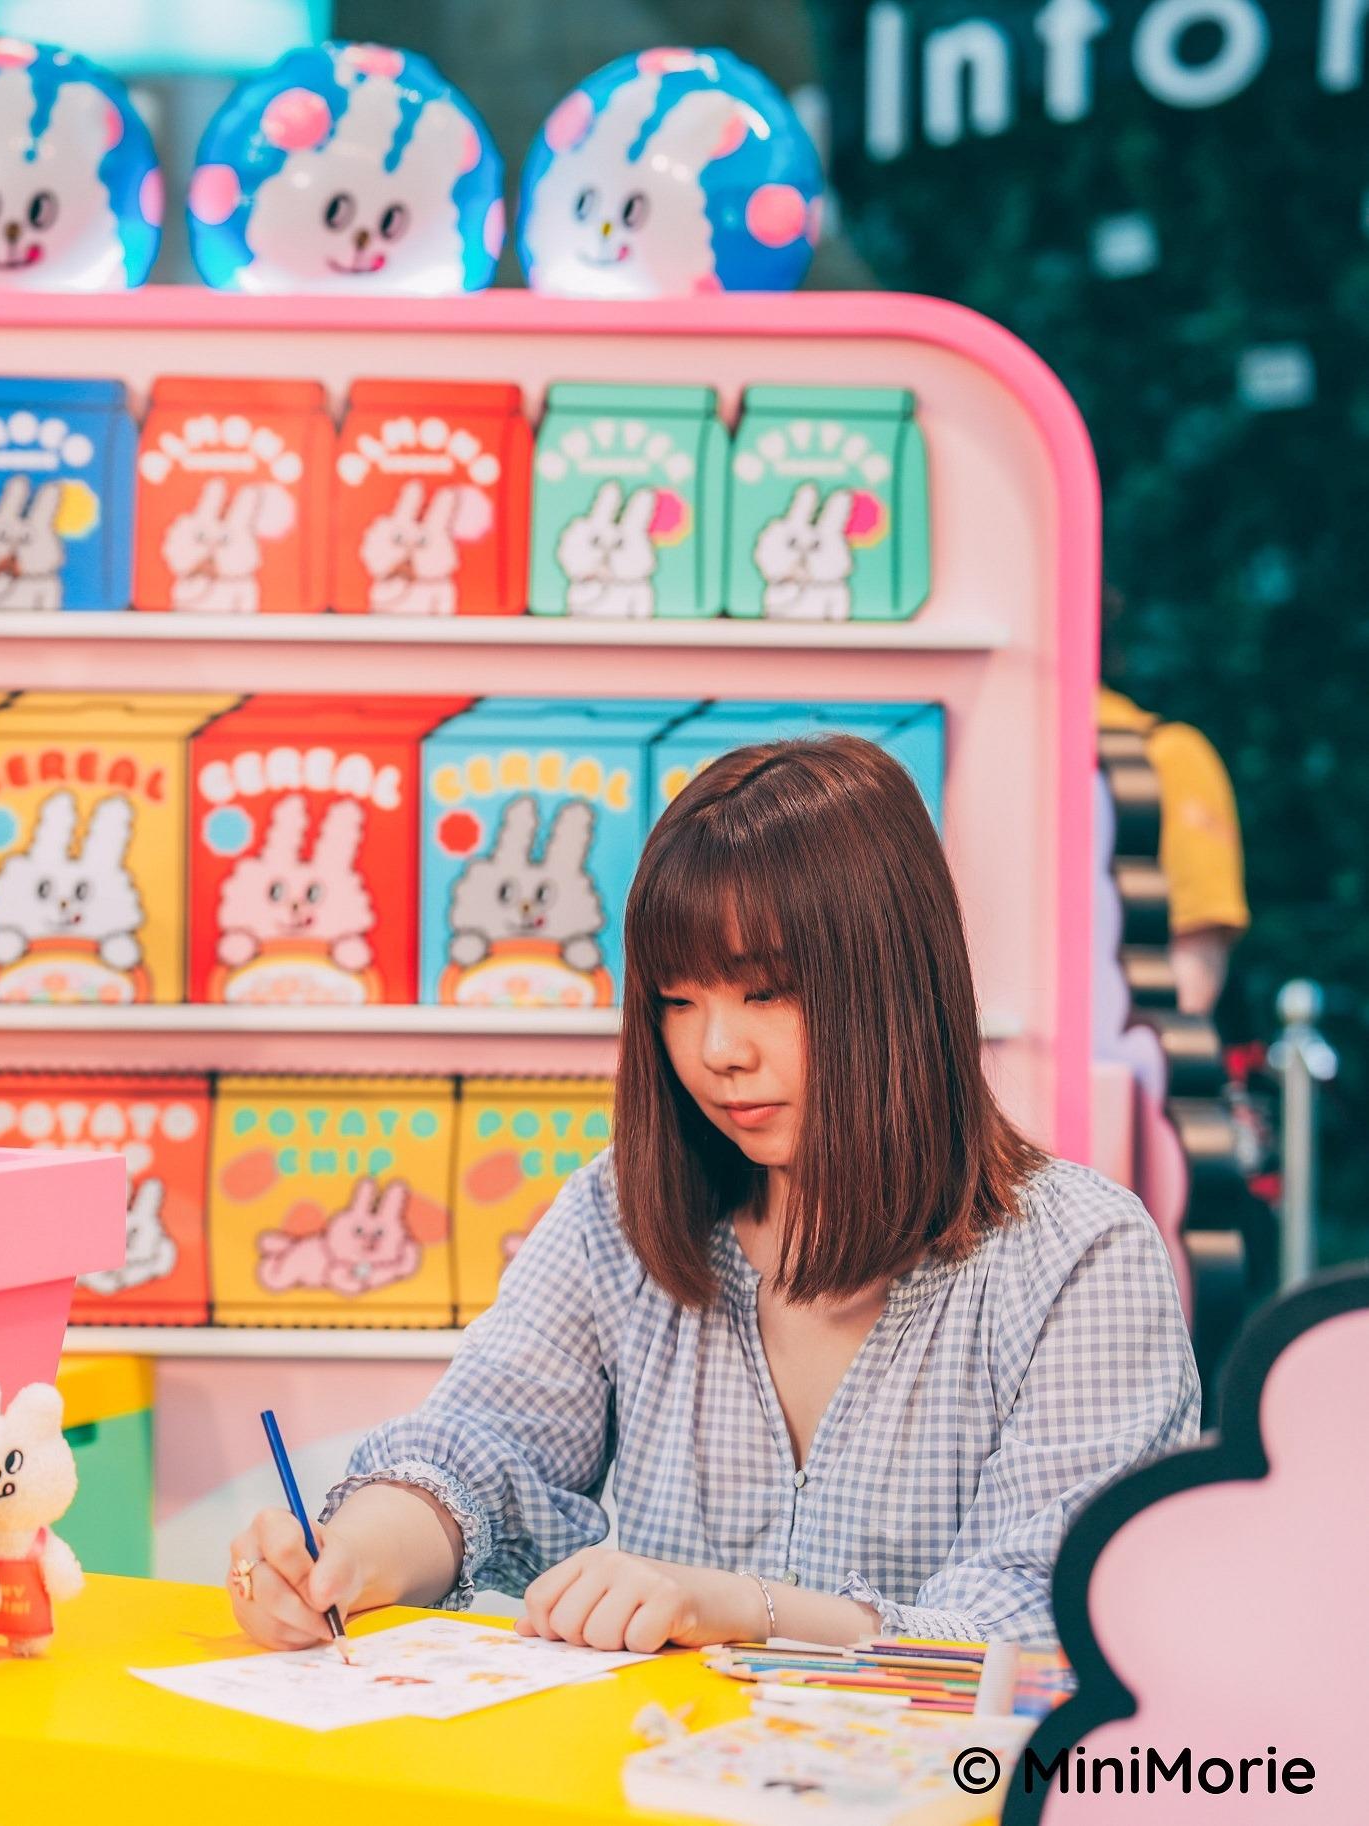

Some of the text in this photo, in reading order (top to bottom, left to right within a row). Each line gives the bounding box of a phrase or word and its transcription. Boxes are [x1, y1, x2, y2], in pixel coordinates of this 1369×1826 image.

[198, 746, 402, 811] CEREAL
[434, 750, 630, 812] CEREAL
[232, 1107, 440, 1138] POTATO
[477, 1108, 610, 1139] POTA
[278, 1147, 396, 1178] CHIP
